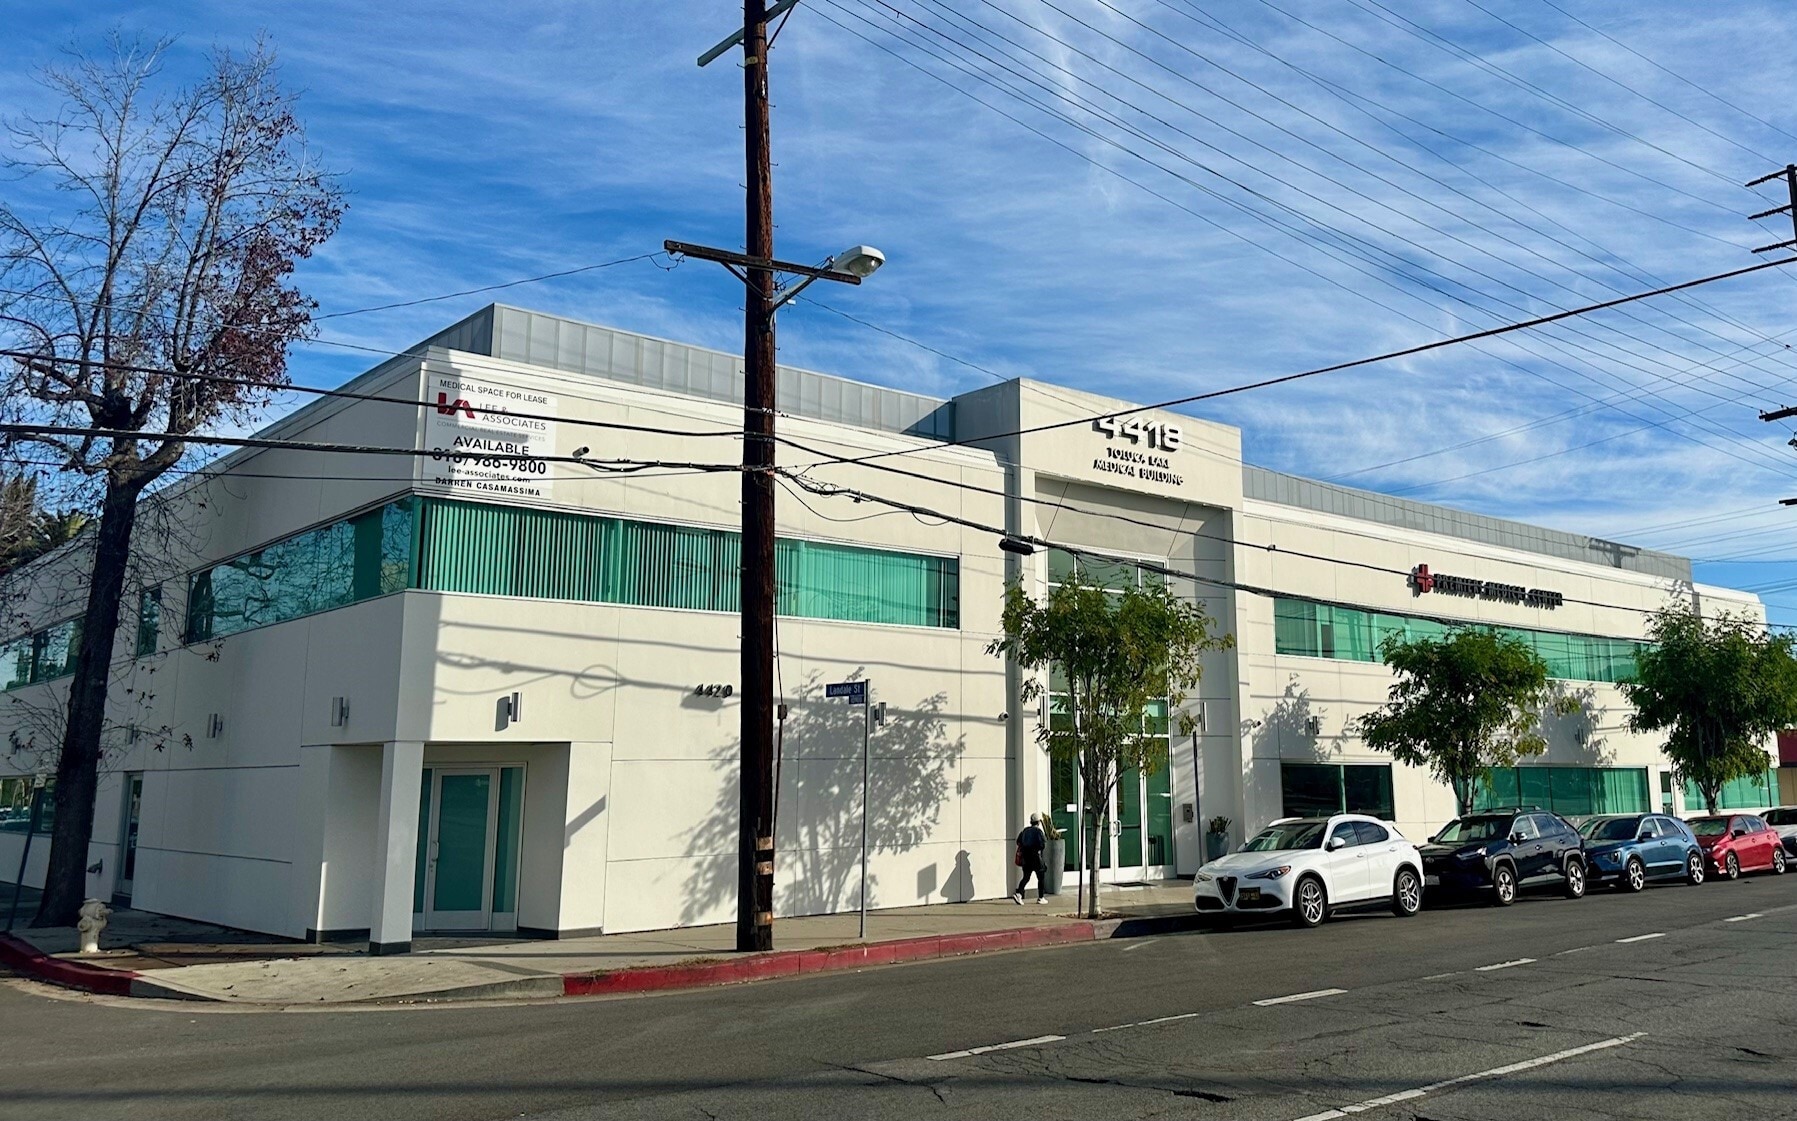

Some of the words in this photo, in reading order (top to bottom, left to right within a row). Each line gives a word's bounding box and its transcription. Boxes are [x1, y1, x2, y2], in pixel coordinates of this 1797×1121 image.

[440, 379, 475, 393] MEDICAL
[477, 386, 504, 398] SPACE
[505, 391, 522, 400] FOR
[523, 395, 548, 404] LEASE
[437, 421, 477, 432] COMMERCIAL
[479, 427, 494, 435] REAL
[495, 430, 517, 438] ESTATE
[518, 433, 546, 442] SERVICES
[482, 413, 546, 431] ASSOCIATES
[1092, 414, 1183, 452] 4418
[453, 435, 530, 456] AVAILABLE
[448, 465, 531, 484] lee-associates.com
[1139, 468, 1184, 486] BUILDING
[435, 477, 473, 489] DARREN
[476, 482, 541, 497] CASAMASSIMA
[693, 683, 733, 698] 4420
[853, 683, 861, 694] St
